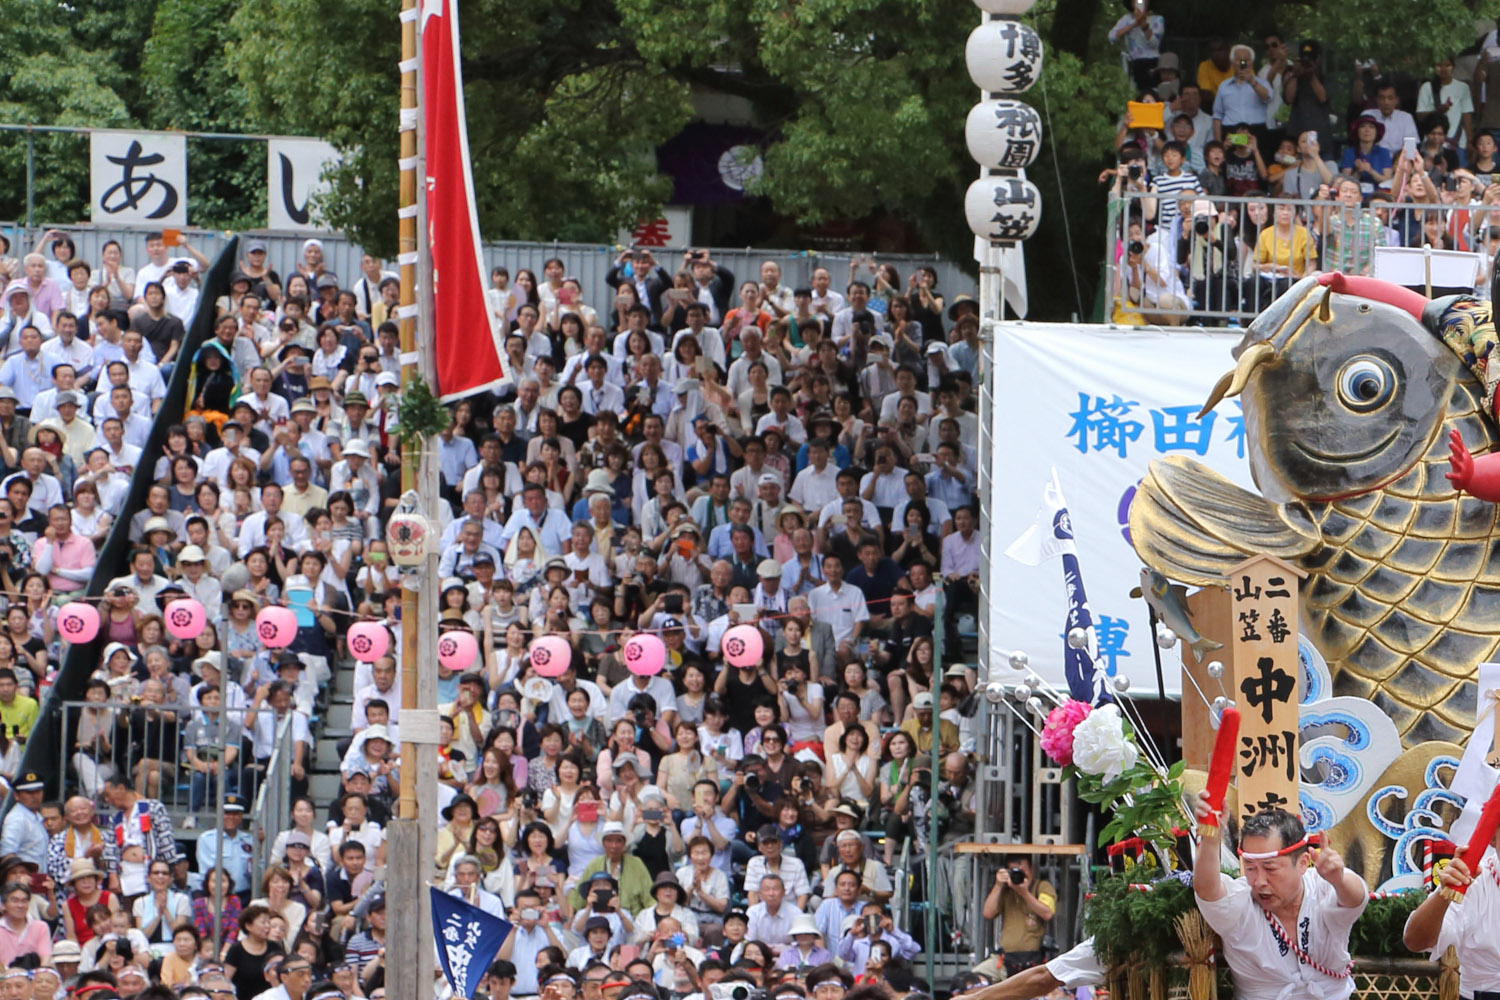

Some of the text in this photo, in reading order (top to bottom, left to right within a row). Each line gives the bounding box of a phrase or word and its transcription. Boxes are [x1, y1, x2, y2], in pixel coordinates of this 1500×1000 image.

[1000, 24, 1040, 92] 博多
[100, 140, 178, 219] あ
[990, 179, 1035, 241] 山笠
[1234, 576, 1261, 642] 山笠
[1265, 577, 1291, 643] 二番
